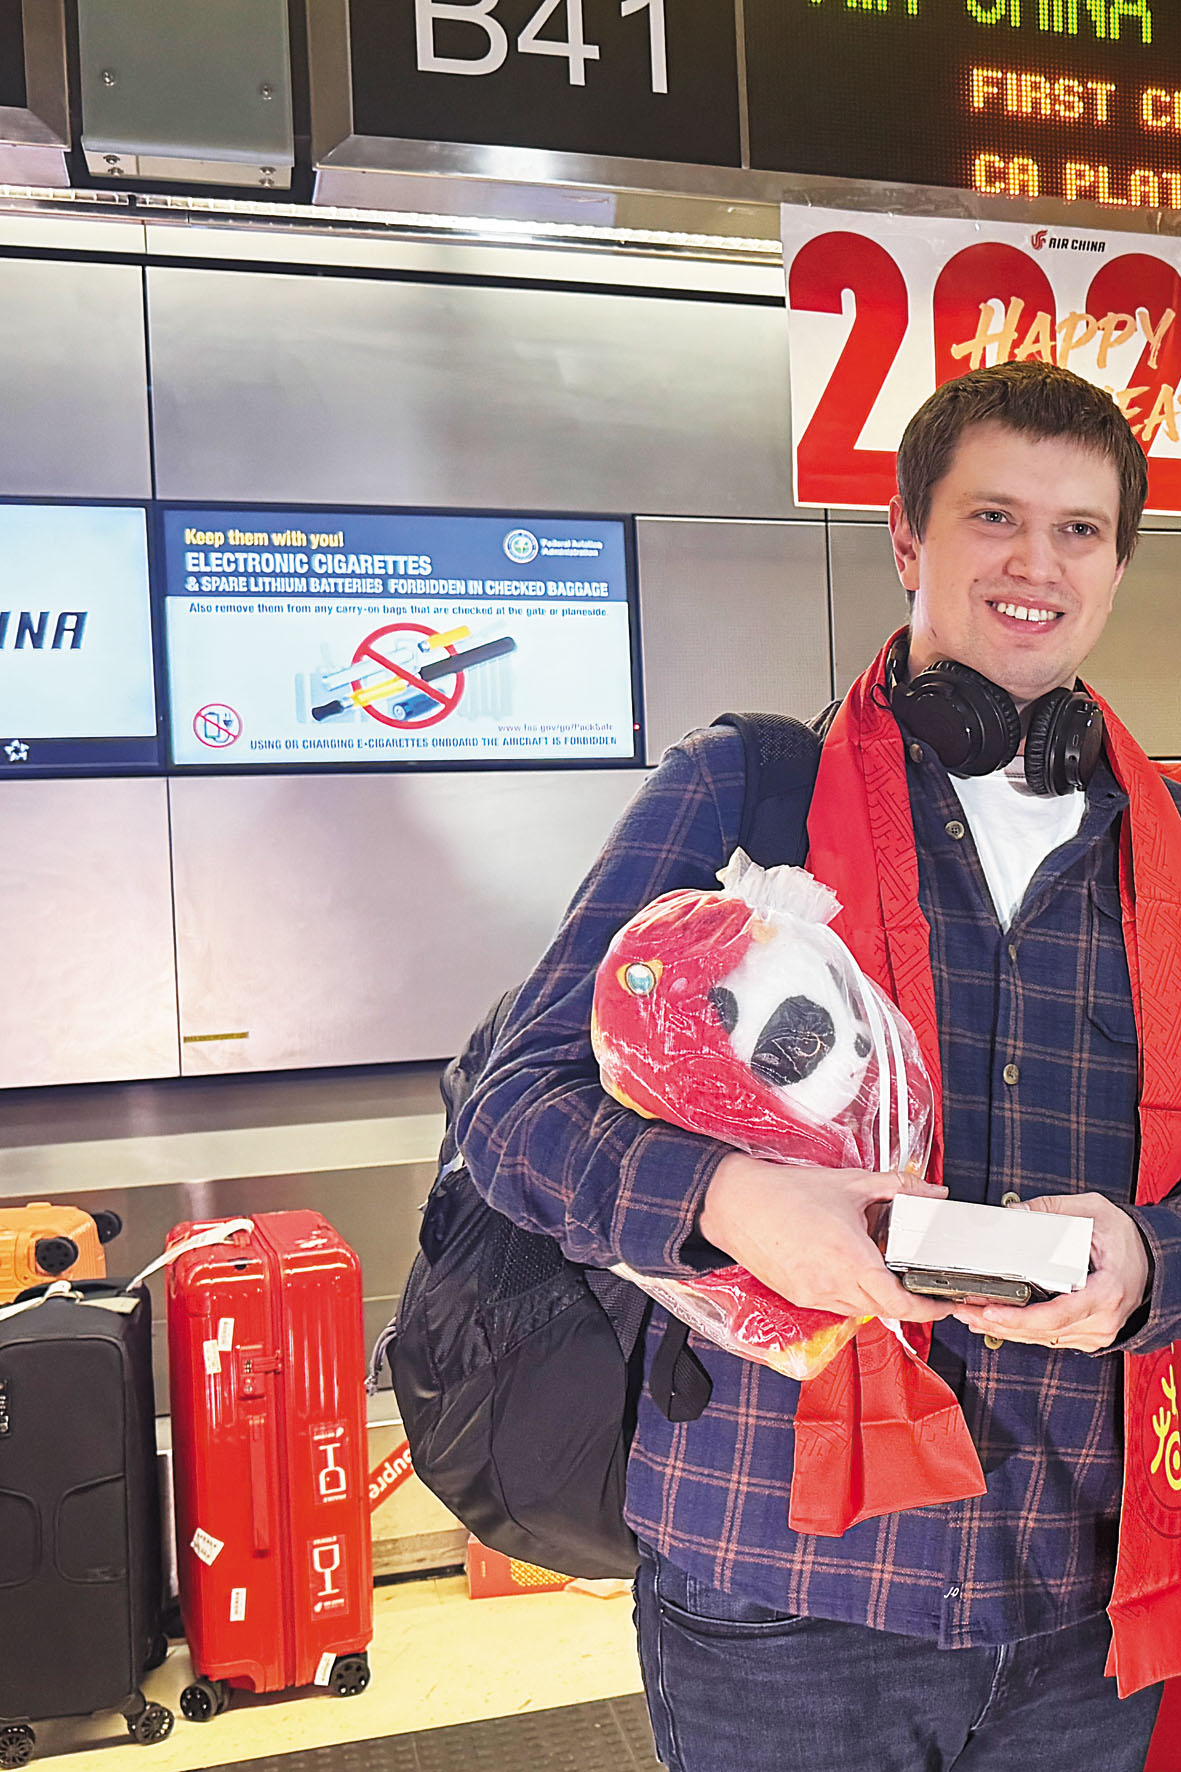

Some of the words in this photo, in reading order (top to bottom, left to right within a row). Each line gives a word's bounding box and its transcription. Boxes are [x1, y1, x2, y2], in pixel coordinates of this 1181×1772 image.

[415, 0, 668, 94] B41
[972, 67, 1116, 122] FIRST
[974, 154, 1040, 198] CA
[1048, 237, 1070, 250] AIR
[1070, 239, 1106, 253] CHINA
[950, 296, 1177, 371] HAPPY
[184, 528, 225, 548] Keep
[227, 529, 269, 547] them
[271, 530, 307, 547] with
[310, 531, 345, 549] you!
[184, 551, 309, 573] ELECTRONIC
[312, 553, 433, 575] CIGARETTES
[185, 577, 199, 592] &
[201, 576, 248, 592] SPARE
[250, 577, 308, 593] LITHIUM
[310, 577, 383, 593] BATTERIES
[388, 578, 466, 595] FORBIDDEN
[468, 580, 483, 595] IN
[485, 580, 545, 596] CHECKED
[547, 582, 609, 597] BAGGAGE
[189, 602, 213, 613] Also
[215, 604, 255, 613] remove
[258, 603, 284, 613] them
[287, 603, 311, 613] from
[314, 605, 333, 615] any
[336, 605, 380, 616] carry-on
[383, 604, 408, 616] bags
[410, 605, 430, 615] that
[433, 607, 449, 615] are
[452, 605, 493, 615] checked
[496, 606, 505, 615] at
[508, 605, 524, 615] the
[526, 607, 547, 617] gate
[250, 739, 282, 750] USING
[285, 739, 300, 749] OR
[302, 738, 354, 749] CHARGING
[357, 737, 429, 749] E-CIGARETTES
[431, 737, 479, 748] ONBOARD
[481, 736, 499, 747] THE
[502, 736, 548, 746] AIRCRAFT
[552, 736, 562, 745] IS
[564, 735, 617, 745] FORBIDDEN
